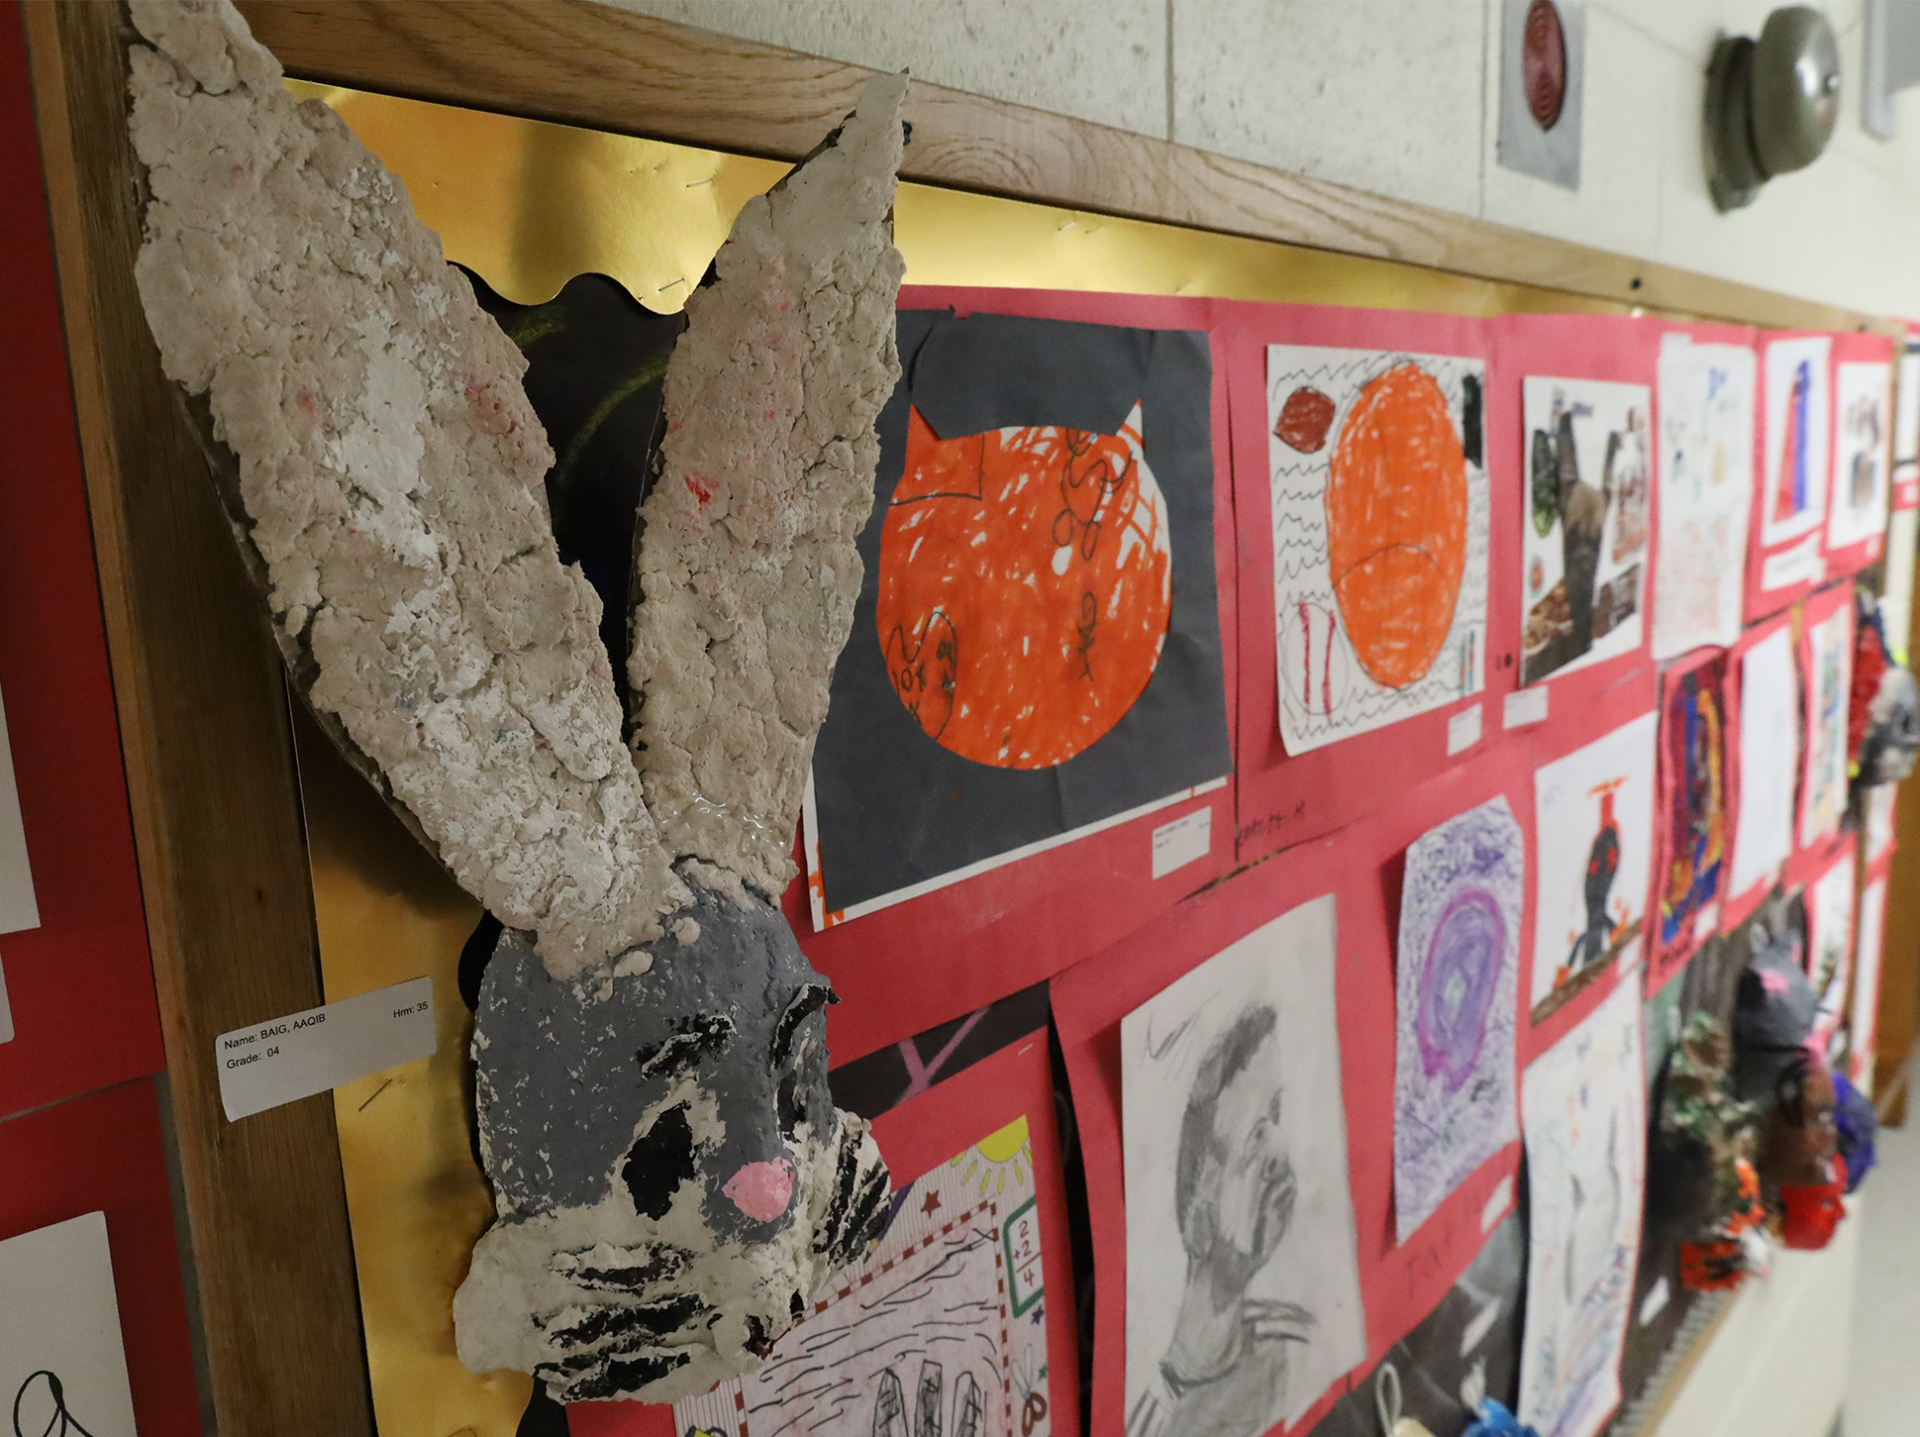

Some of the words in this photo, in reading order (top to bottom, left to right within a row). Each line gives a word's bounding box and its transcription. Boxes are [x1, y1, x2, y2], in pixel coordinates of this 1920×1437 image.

[393, 1006, 415, 1018] Hrm:
[416, 1001, 429, 1011] 35
[224, 1034, 258, 1049] Name:
[260, 1024, 290, 1040] BAIG,
[293, 1013, 326, 1030] AAQIB
[226, 1053, 262, 1069] Grade:
[266, 1046, 280, 1058] 04
[1019, 1220, 1030, 1238] 2
[1023, 1268, 1035, 1287] 4
